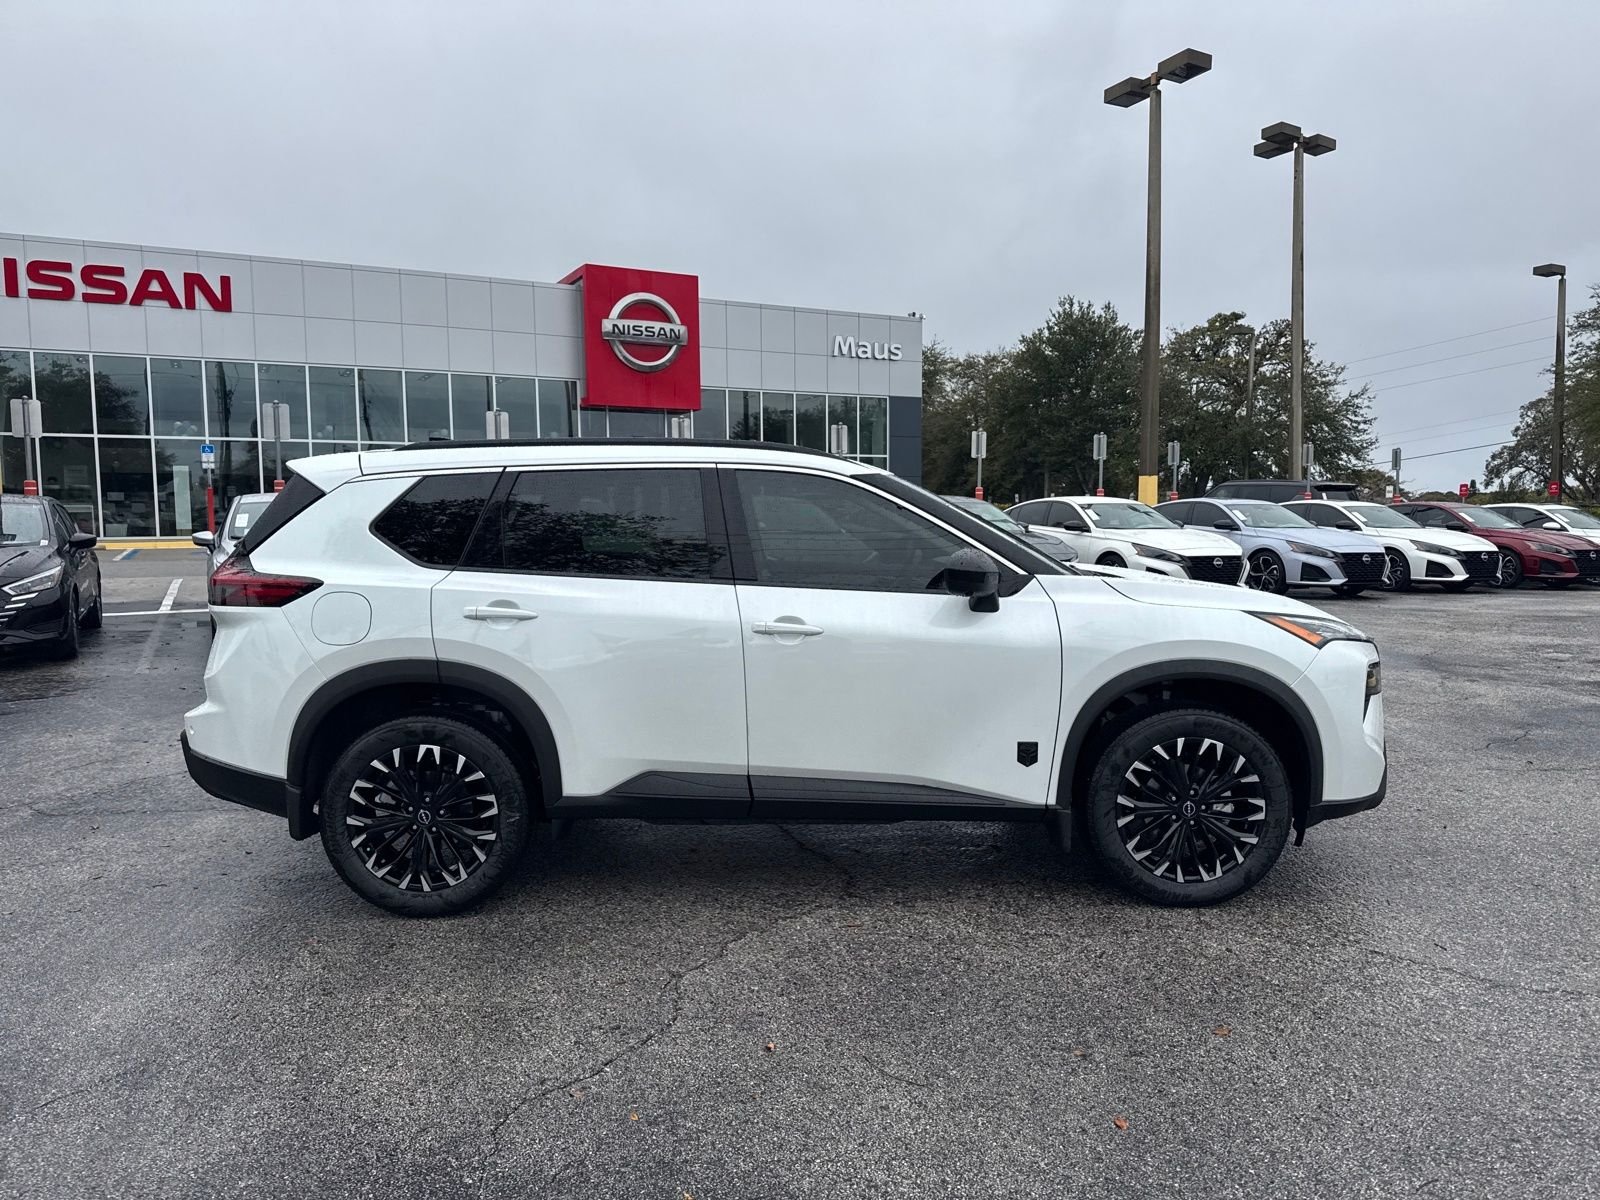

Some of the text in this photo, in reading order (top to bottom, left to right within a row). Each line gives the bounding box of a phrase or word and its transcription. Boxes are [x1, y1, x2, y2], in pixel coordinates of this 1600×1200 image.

[3, 257, 232, 312] ISSAN
[611, 323, 681, 340] NISSAN
[833, 335, 903, 361] Maus
